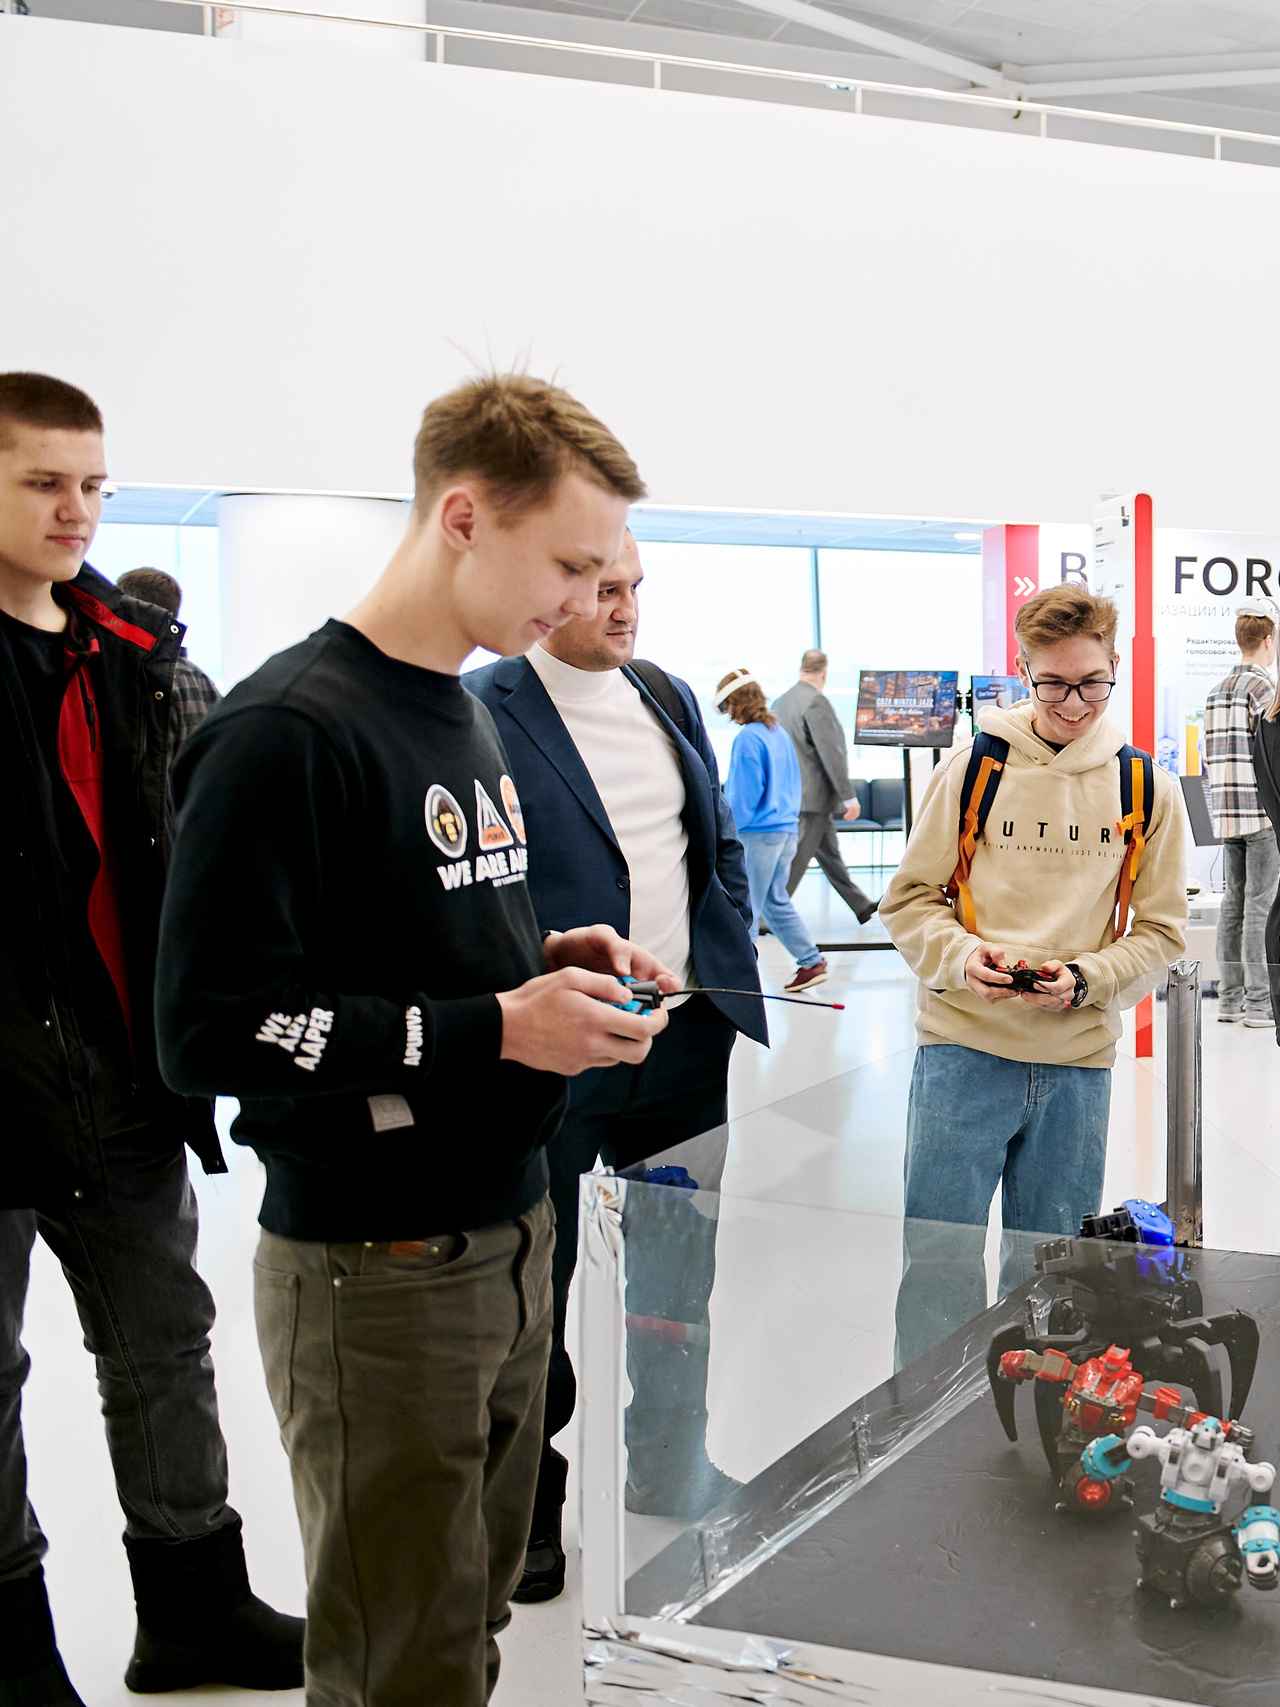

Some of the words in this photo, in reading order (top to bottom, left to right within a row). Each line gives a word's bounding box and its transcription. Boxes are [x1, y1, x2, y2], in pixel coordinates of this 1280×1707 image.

[1002, 820, 1130, 845] UTUR
[437, 860, 473, 890] WE
[476, 852, 509, 882] ARE
[255, 1011, 292, 1043] WE
[293, 1007, 335, 1072] AAPER
